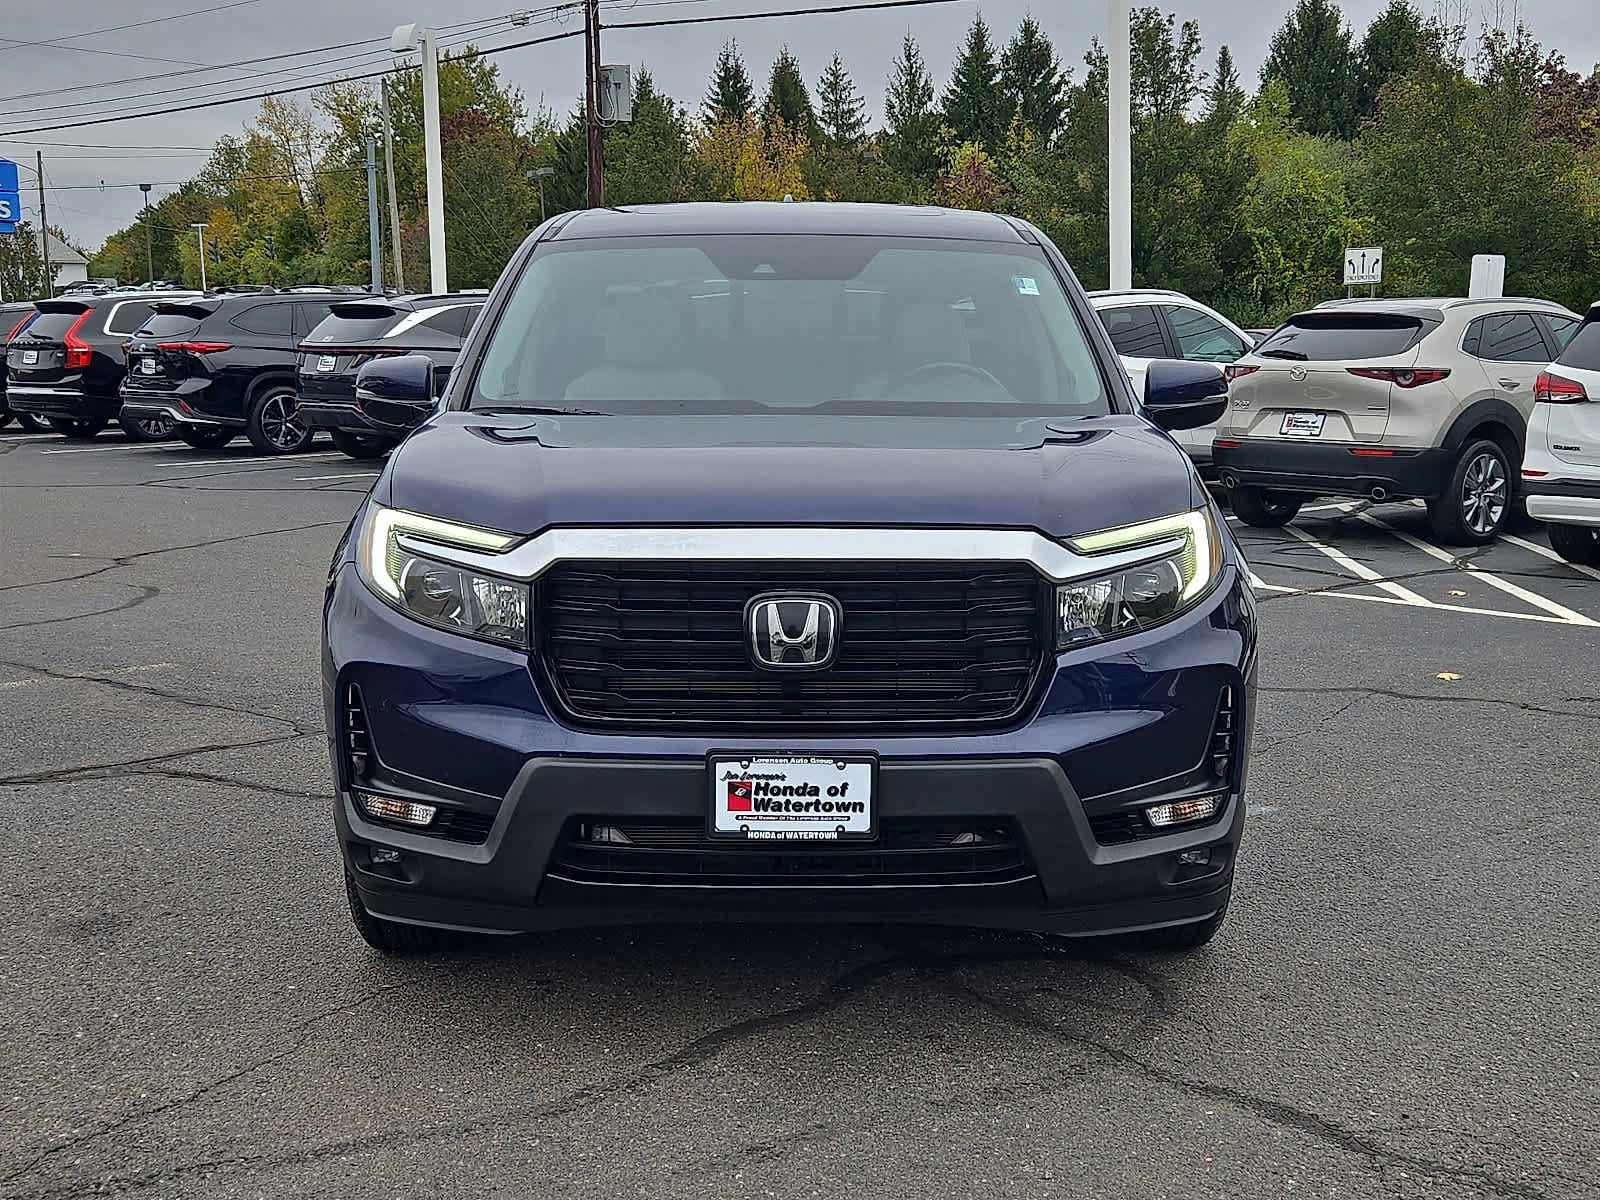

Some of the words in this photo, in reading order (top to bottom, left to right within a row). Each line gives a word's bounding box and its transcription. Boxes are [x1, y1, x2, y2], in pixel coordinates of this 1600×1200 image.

[789, 757, 809, 765] Auto
[810, 758, 834, 766] Group
[753, 781, 821, 798] Honda
[826, 781, 850, 798] of
[753, 797, 865, 813] Watertown
[747, 831, 777, 839] HONDA
[777, 831, 785, 839] of
[785, 831, 838, 840] WATERTOWN
